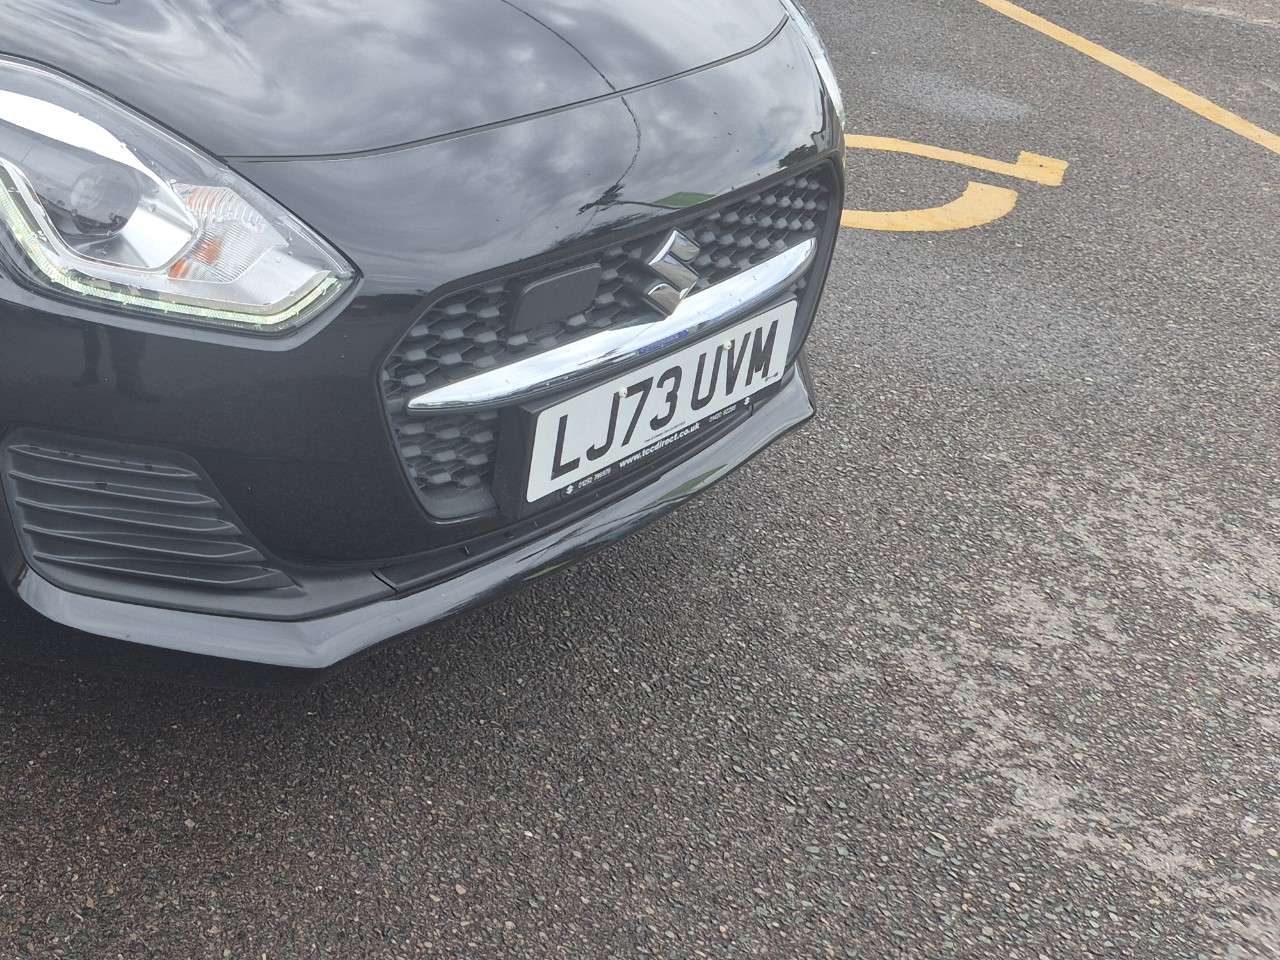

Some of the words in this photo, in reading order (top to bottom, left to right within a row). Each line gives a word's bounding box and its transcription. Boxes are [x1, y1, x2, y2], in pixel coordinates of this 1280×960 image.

[550, 366, 683, 481] LJ73
[690, 319, 779, 411] UVM
[619, 422, 701, 468] www.tccdirect.co.uk
